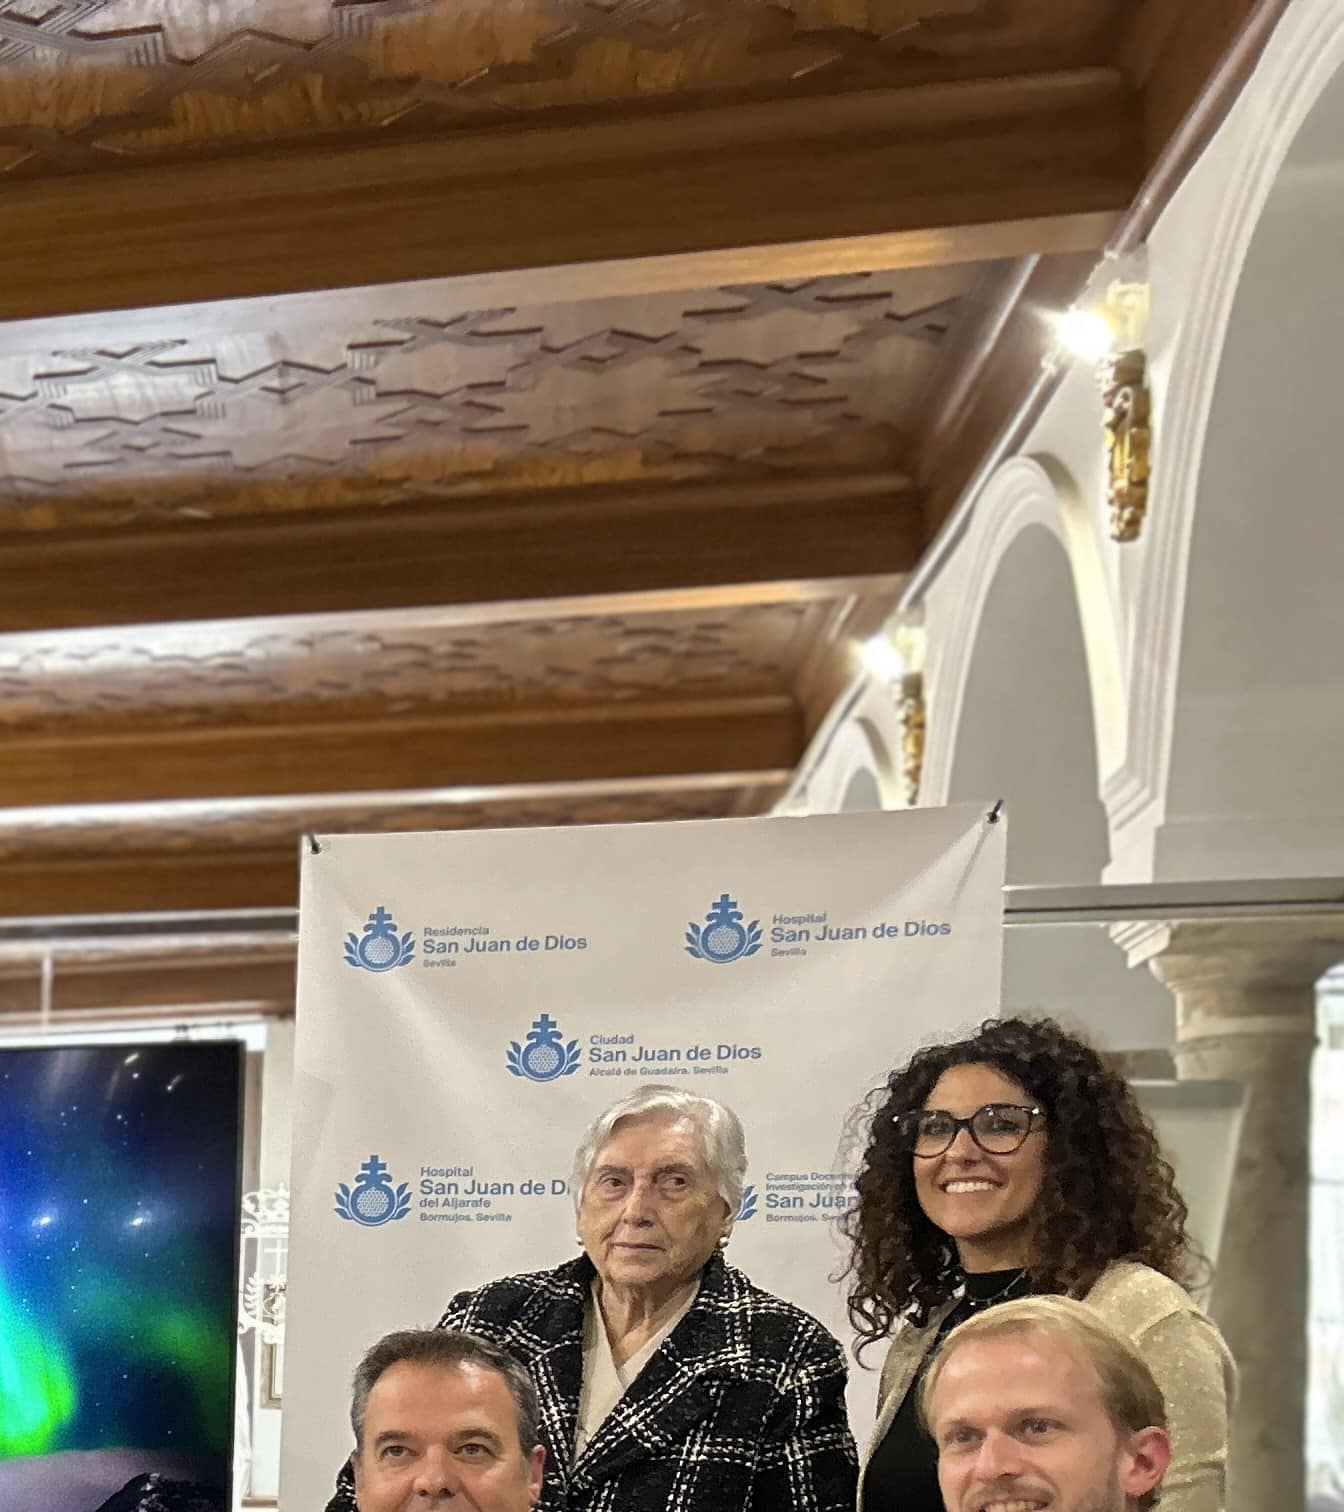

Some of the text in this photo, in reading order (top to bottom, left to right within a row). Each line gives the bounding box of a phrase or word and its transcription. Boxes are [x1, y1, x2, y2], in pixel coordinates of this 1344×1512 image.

[772, 913, 827, 926] Hospital
[423, 926, 490, 937] Residencia
[771, 920, 952, 942] San Juan de Dios
[423, 935, 588, 954] San Juan de Dios
[771, 947, 807, 957] Sevilla
[423, 959, 457, 967] Sevilla
[590, 1034, 634, 1045] Ciudad
[589, 1044, 762, 1062] San Juan de Dios
[623, 1067, 637, 1076] de
[420, 1166, 474, 1179] Hospital
[419, 1179, 459, 1195] San
[464, 1179, 514, 1195] Juan
[519, 1179, 545, 1195] de
[419, 1198, 491, 1210] del Aljarafe
[765, 1193, 804, 1208] San
[476, 1212, 512, 1222] Sevilla
